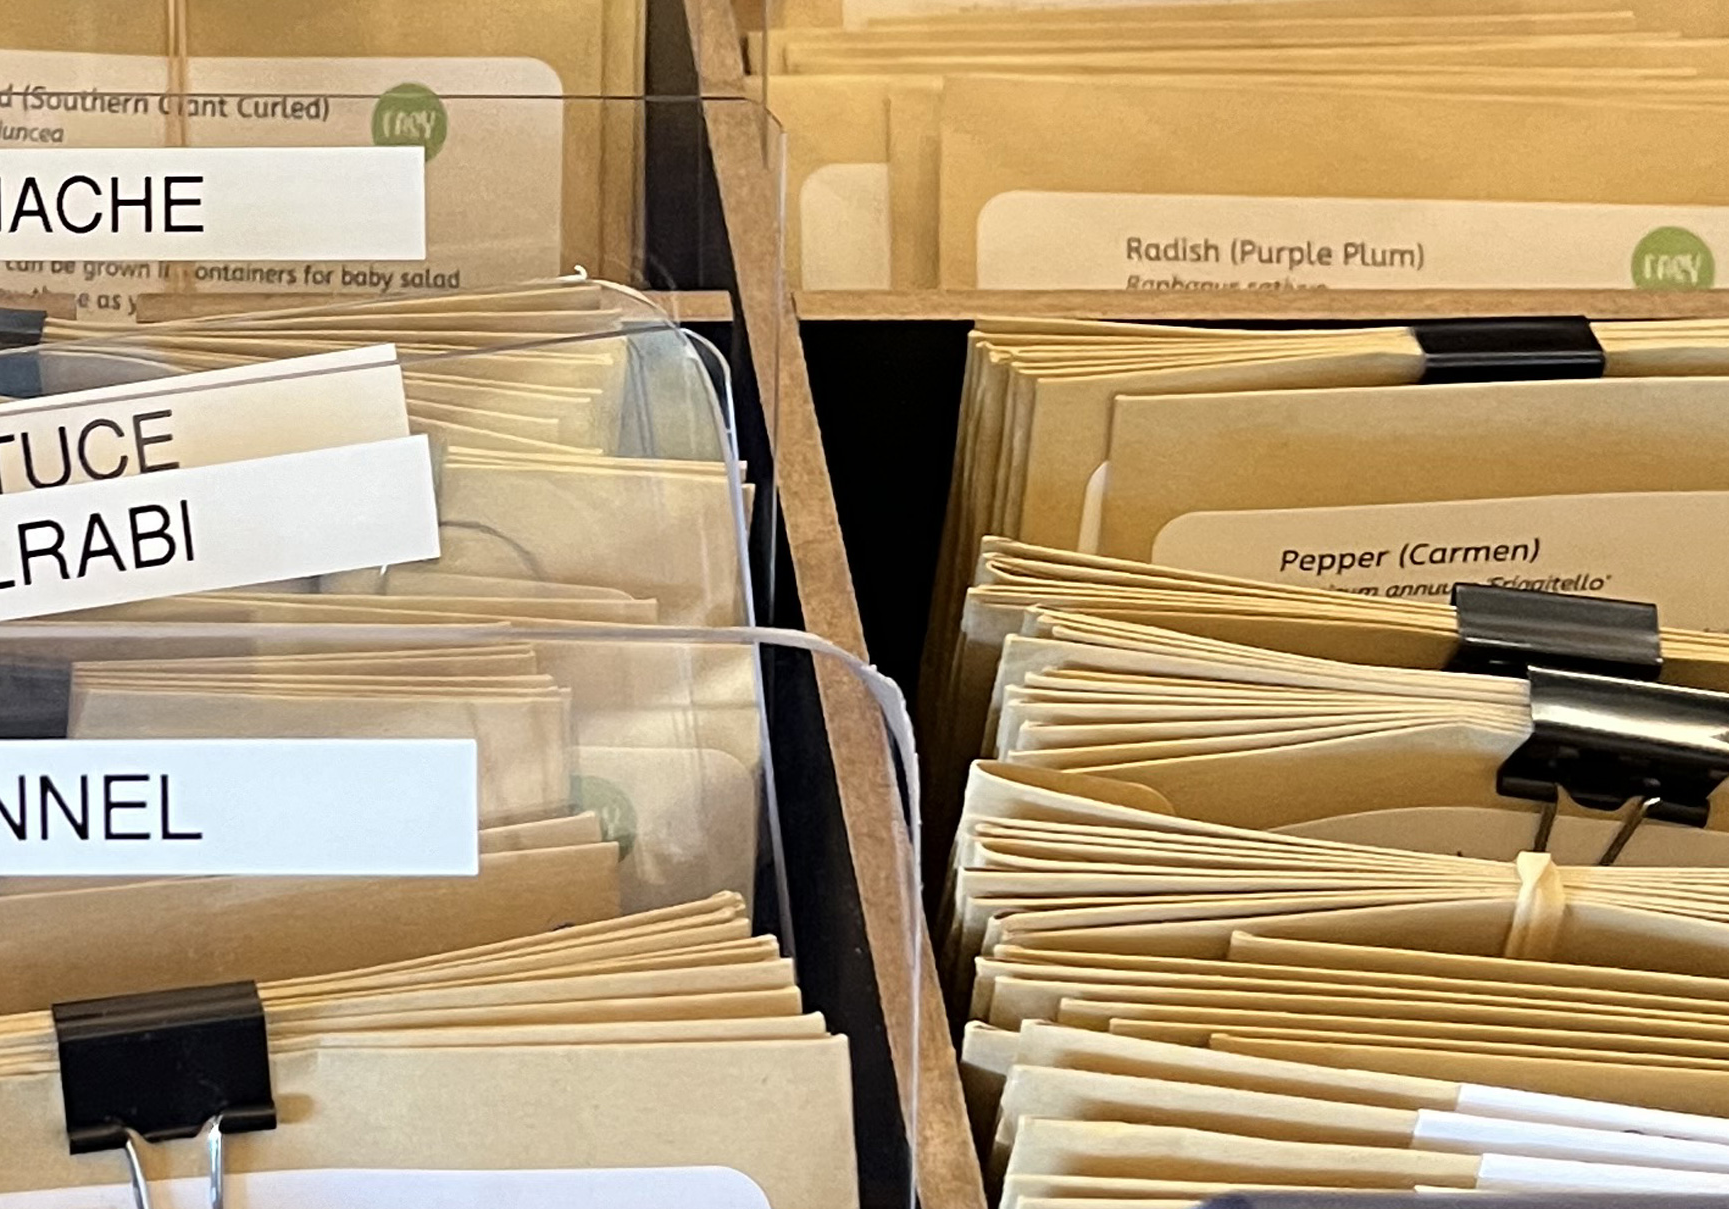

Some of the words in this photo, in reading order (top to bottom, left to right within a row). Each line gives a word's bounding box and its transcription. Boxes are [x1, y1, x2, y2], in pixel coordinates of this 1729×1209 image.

[22, 84, 149, 114] (Southern
[237, 94, 331, 122] Curled)
[1126, 237, 1220, 265] Radish
[1230, 237, 1334, 270] (Purple
[1343, 241, 1426, 272] Plum)
[193, 262, 297, 285] ontainers
[303, 264, 333, 284] for
[341, 265, 394, 293] baby
[400, 269, 461, 290] salad
[1279, 549, 1389, 576] Pepper
[1399, 538, 1540, 569] (Carmen)
